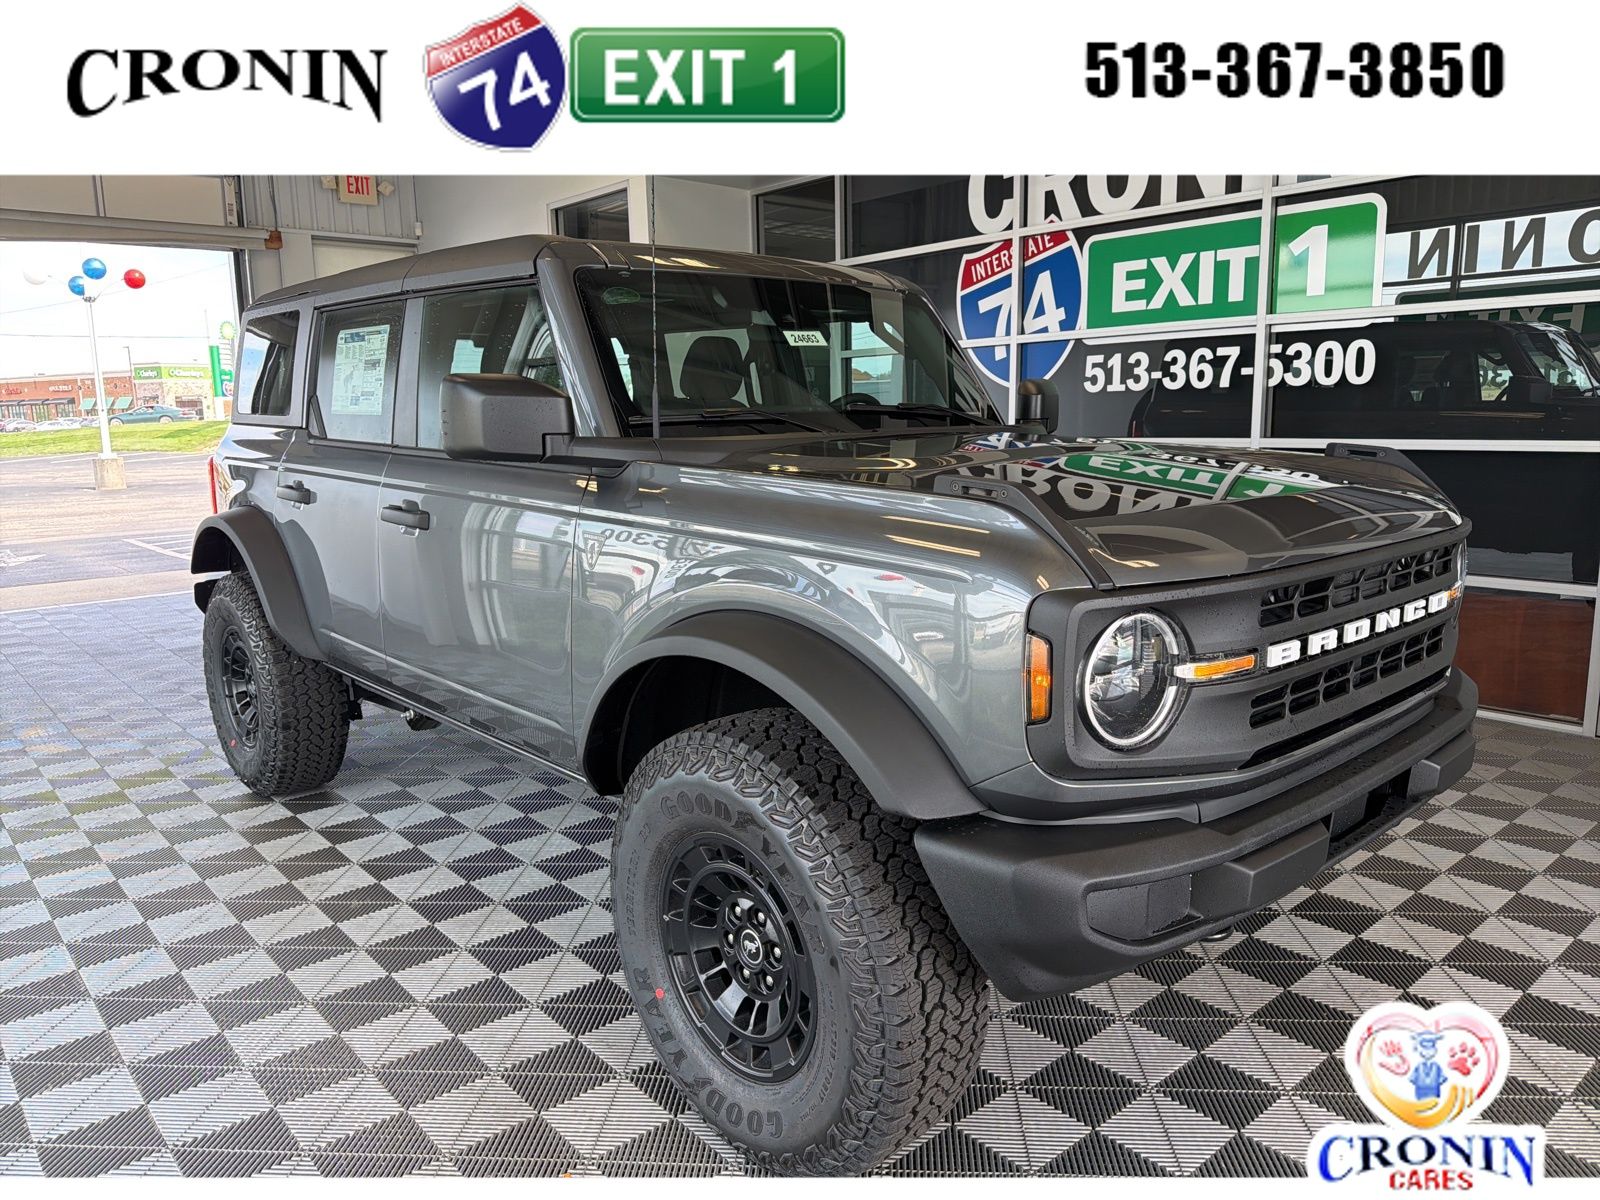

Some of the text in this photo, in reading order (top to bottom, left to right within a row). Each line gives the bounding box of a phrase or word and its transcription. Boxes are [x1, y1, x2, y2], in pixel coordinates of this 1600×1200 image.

[346, 175, 370, 195] EXIT
[1111, 224, 1330, 313] EXIT 1
[977, 269, 1066, 362] 74
[1083, 338, 1377, 393] 513-367-5300
[1266, 590, 1448, 668] BRONCO
